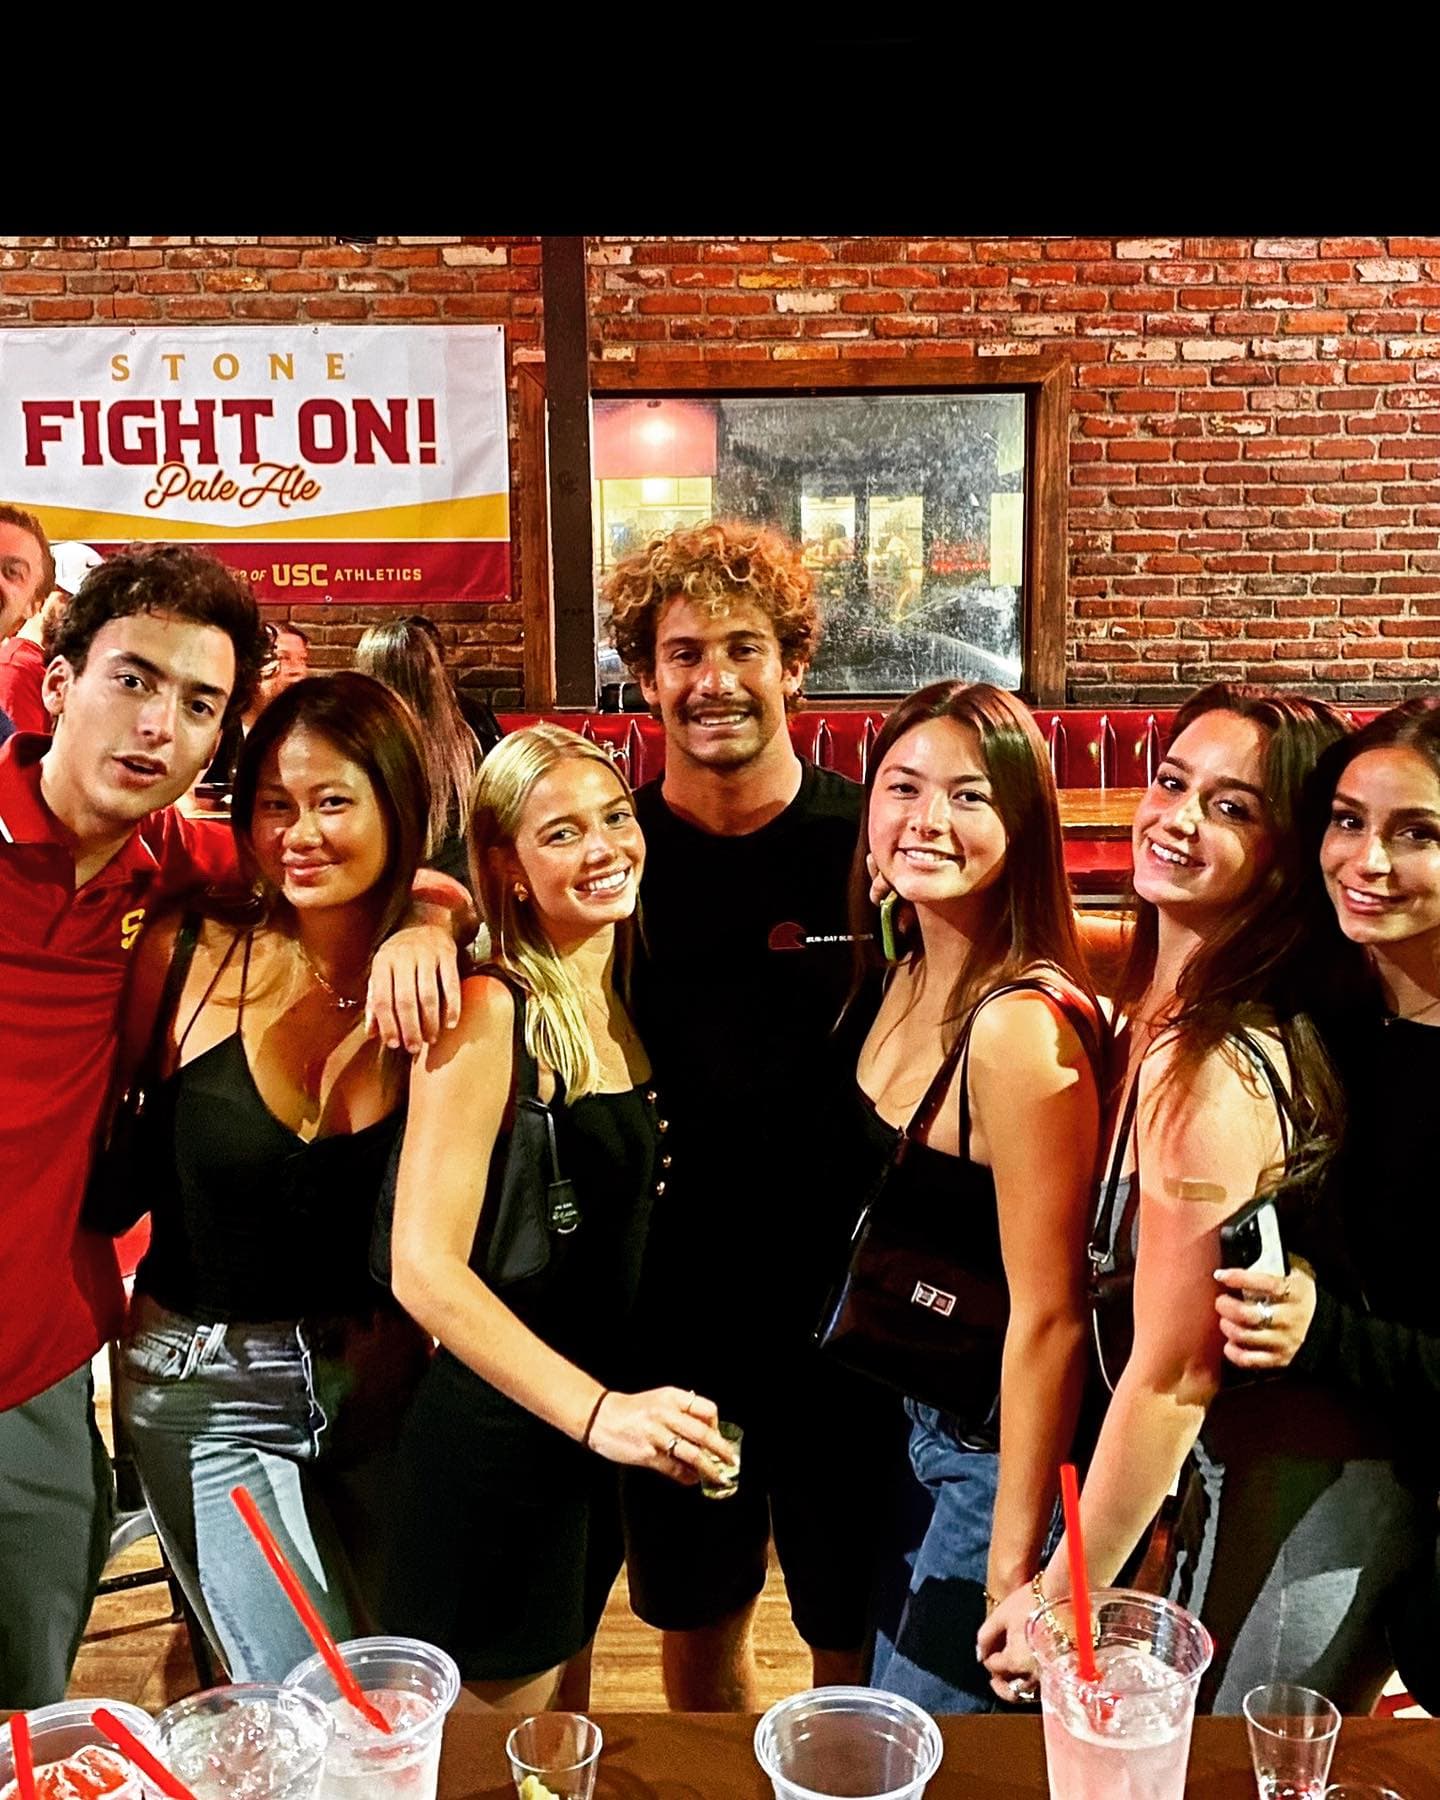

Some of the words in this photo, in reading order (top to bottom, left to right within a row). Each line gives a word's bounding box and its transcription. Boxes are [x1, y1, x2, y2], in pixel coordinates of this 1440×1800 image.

[111, 353, 346, 382] STONE
[21, 399, 274, 467] FIGHT
[298, 398, 437, 466] ON!
[145, 462, 240, 509] Pale
[239, 462, 321, 509] Ale
[250, 569, 267, 581] OF
[272, 564, 328, 587] USC
[334, 568, 422, 582] ATHLETICS
